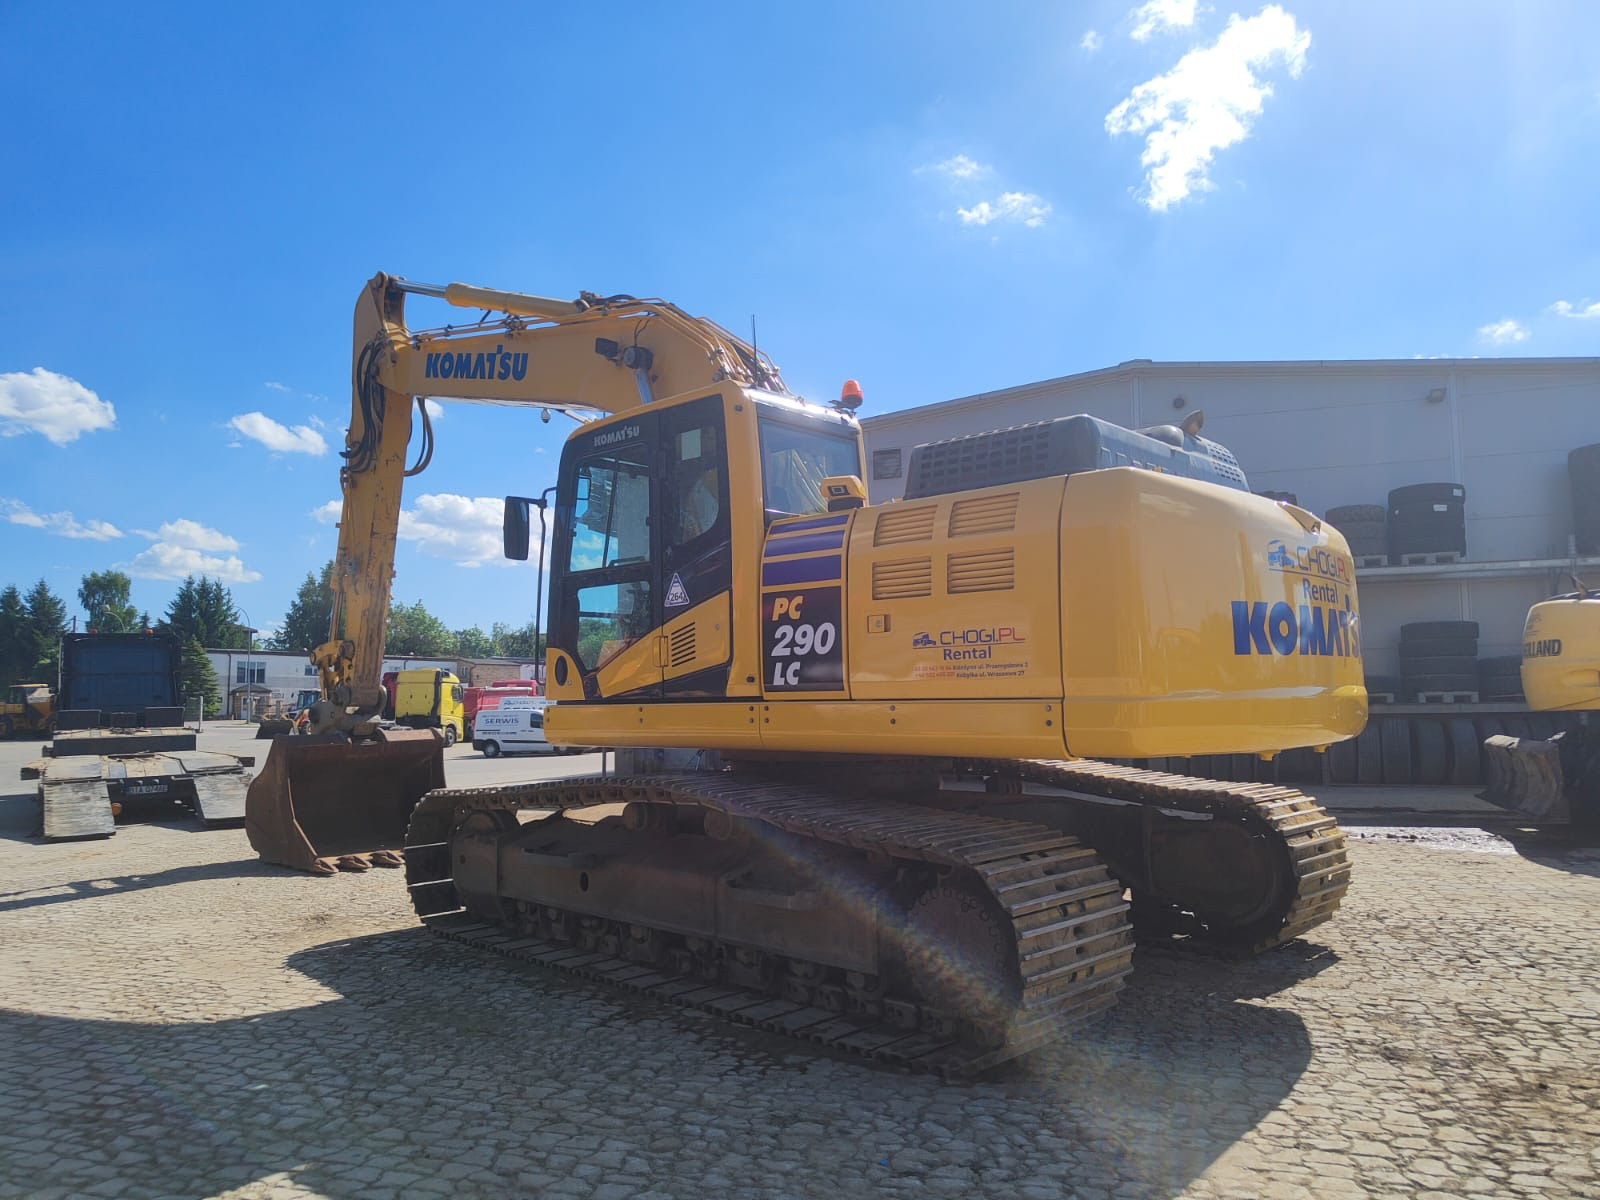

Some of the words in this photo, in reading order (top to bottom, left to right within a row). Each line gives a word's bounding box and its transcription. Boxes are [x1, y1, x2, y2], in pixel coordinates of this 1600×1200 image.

[425, 345, 528, 381] KOMATSU
[594, 425, 640, 447] KOMATSU
[1302, 577, 1338, 604] Rental
[772, 595, 804, 621] PC
[771, 622, 836, 656] 290
[940, 626, 1026, 645] CHOGI.PL
[943, 646, 992, 660] Rental
[773, 661, 801, 685] LC
[484, 717, 519, 725] SERWIS
